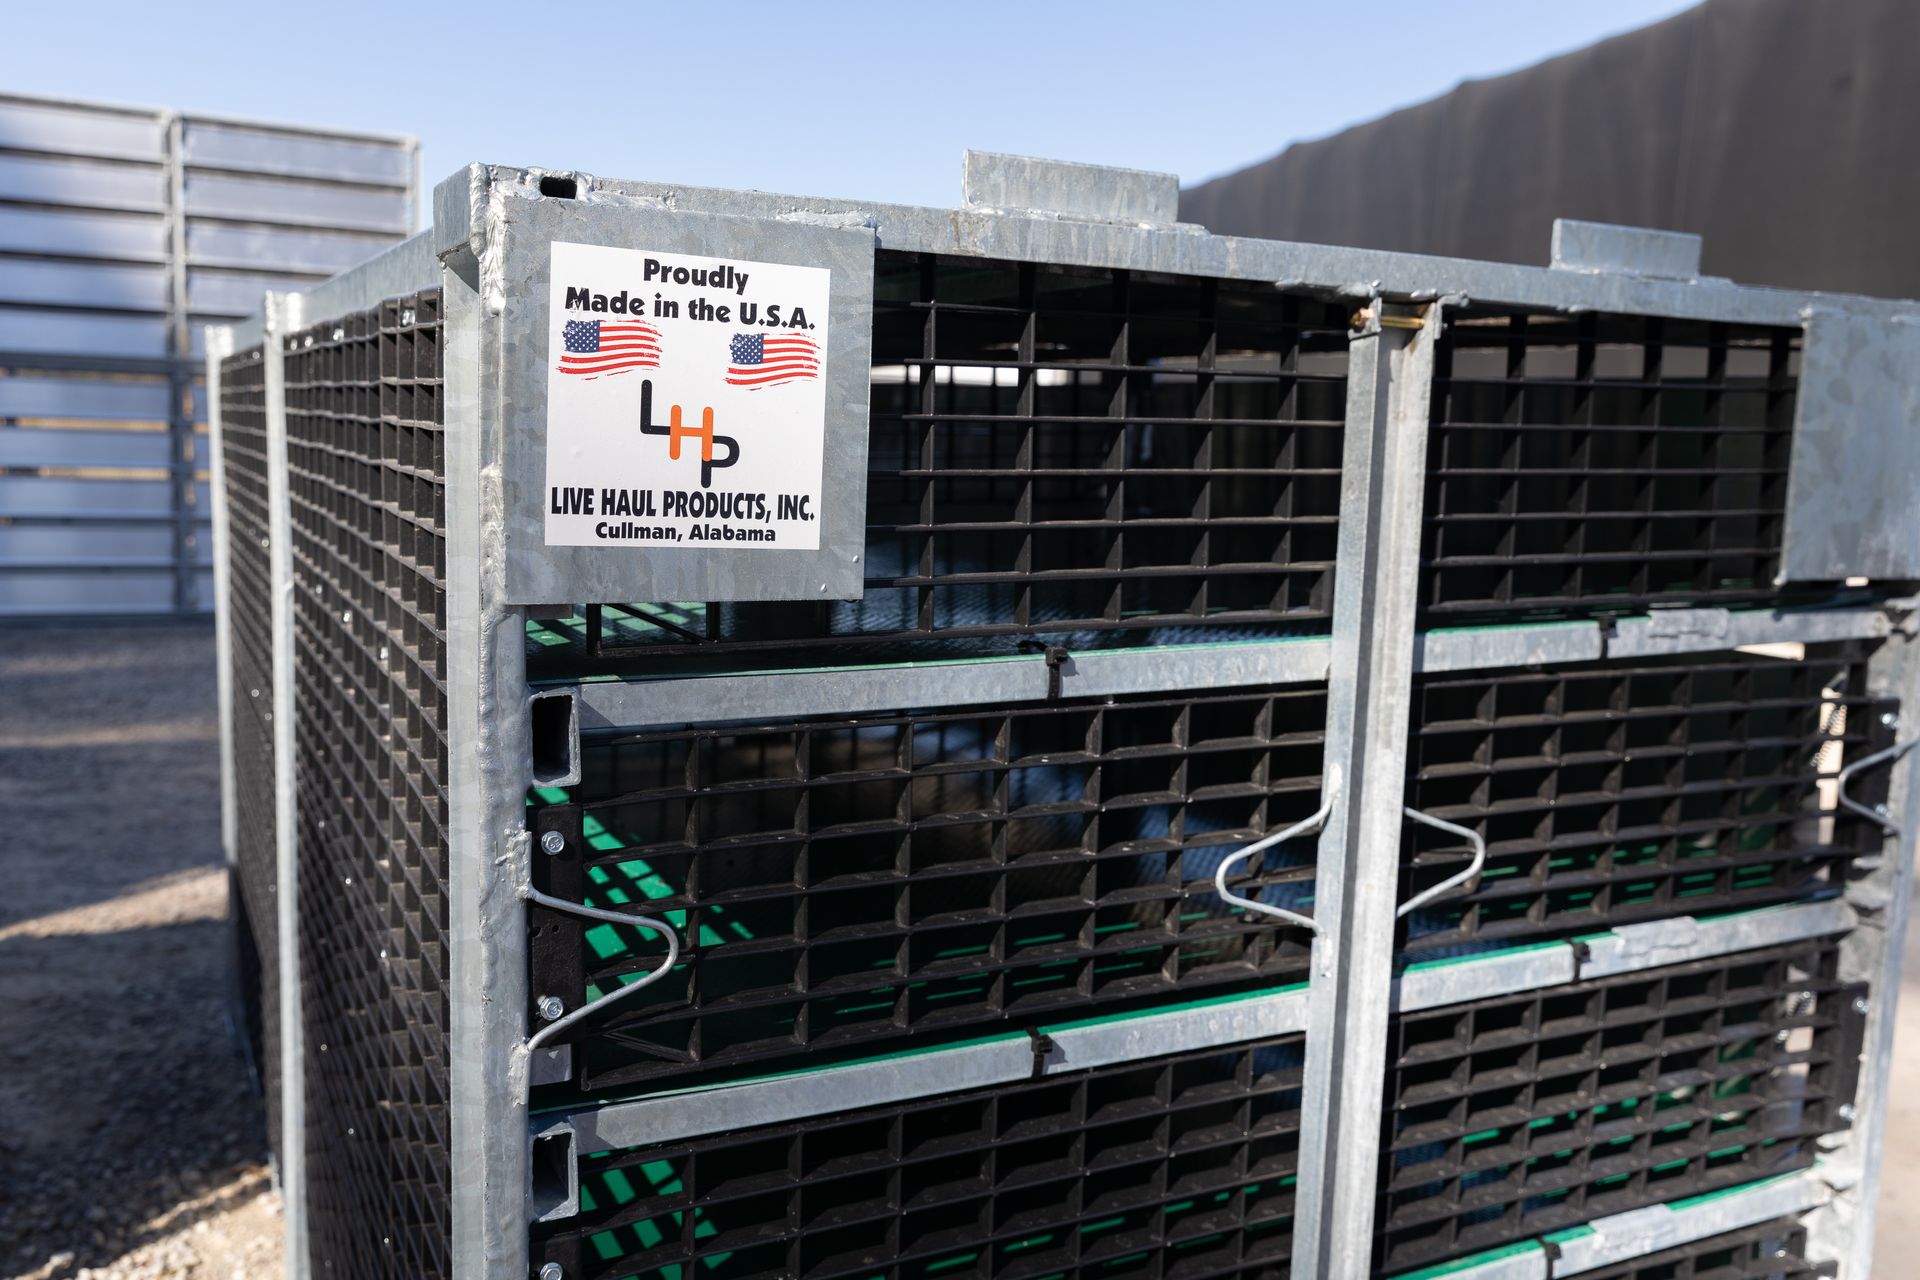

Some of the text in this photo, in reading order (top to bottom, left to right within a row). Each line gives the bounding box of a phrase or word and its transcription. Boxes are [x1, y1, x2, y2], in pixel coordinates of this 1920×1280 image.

[644, 259, 748, 295] Proudly
[565, 287, 815, 329] Made in the U.S.A.
[640, 379, 740, 488] LHP
[552, 487, 814, 523] LIVE HAUL PRODUCTS, INC.
[596, 522, 775, 542] Cullman, Alabama
